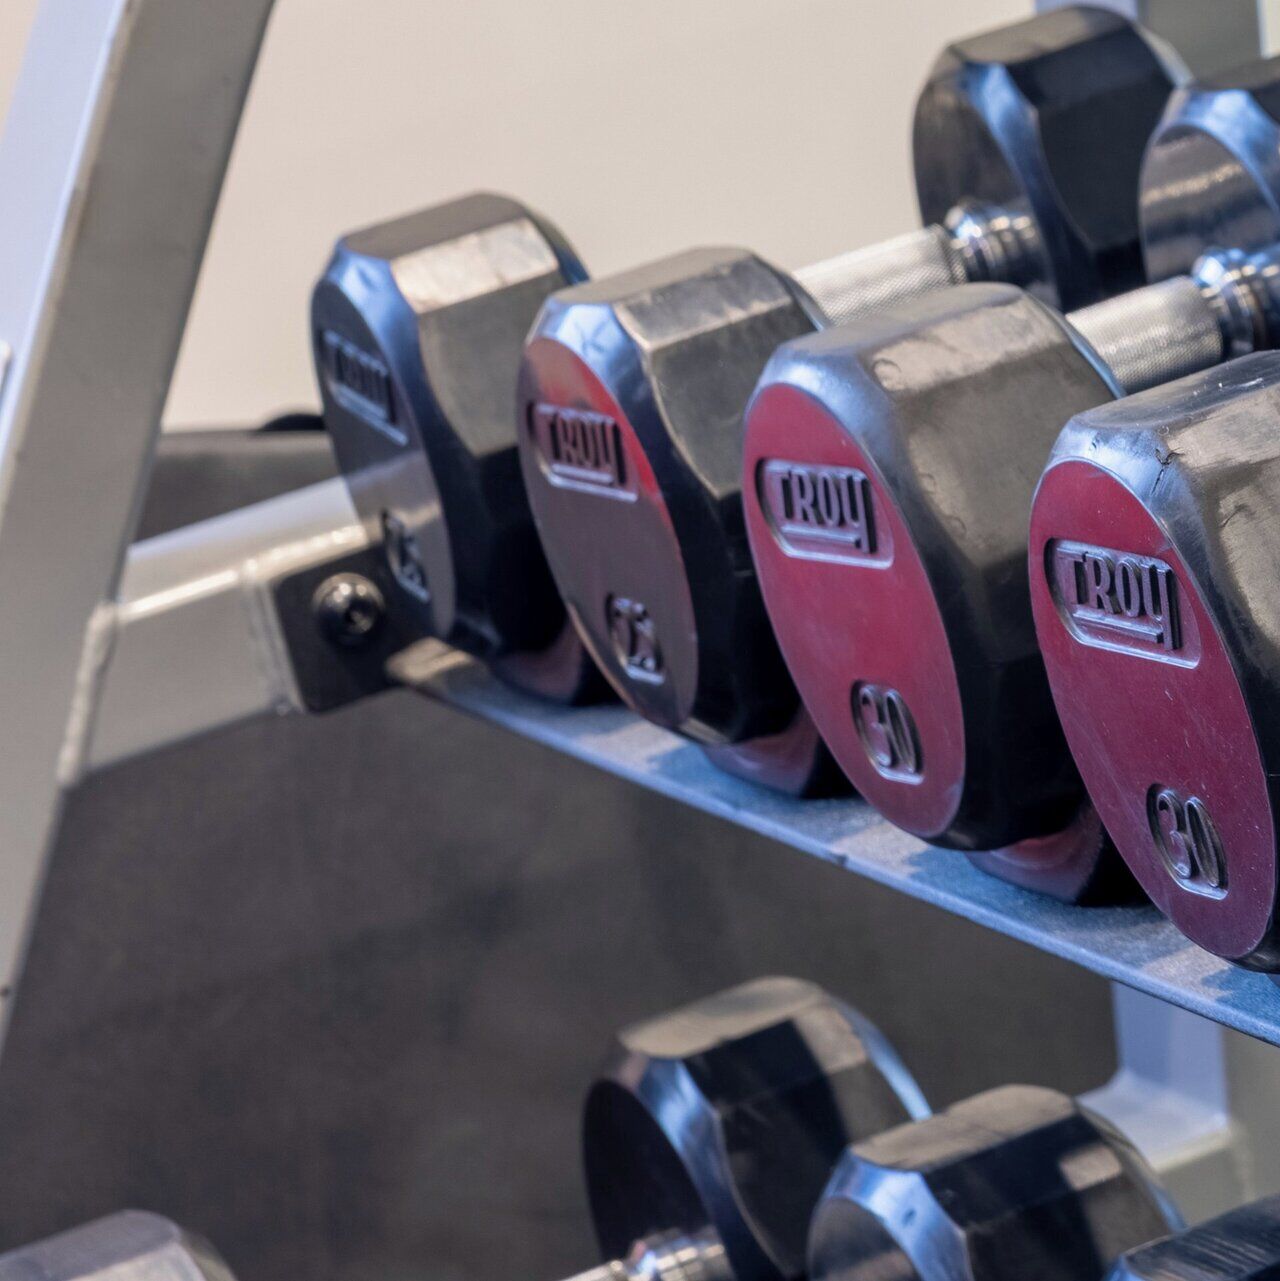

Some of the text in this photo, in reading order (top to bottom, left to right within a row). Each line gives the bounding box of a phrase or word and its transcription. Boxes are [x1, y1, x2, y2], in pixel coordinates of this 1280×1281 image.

[764, 461, 873, 554] TROY
[1055, 542, 1178, 650] TROY
[858, 684, 918, 774] 30
[1156, 789, 1222, 888] 30
